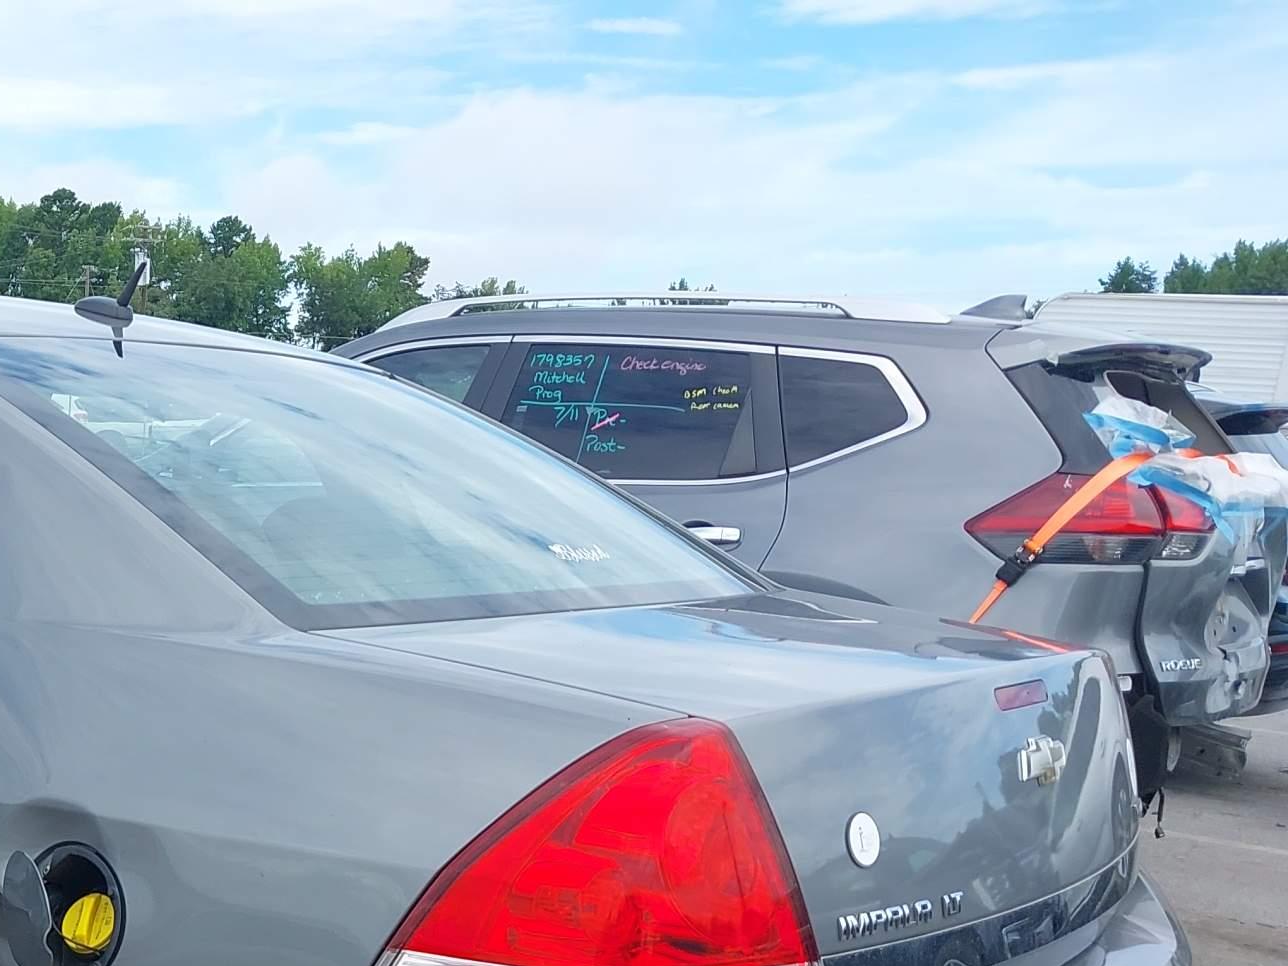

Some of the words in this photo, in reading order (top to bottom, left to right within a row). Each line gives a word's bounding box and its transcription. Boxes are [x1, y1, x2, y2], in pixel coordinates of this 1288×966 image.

[531, 354, 594, 368] 1798357
[620, 356, 659, 370] Check
[534, 371, 585, 384] Mitchell
[529, 385, 561, 405] Prog
[1161, 658, 1202, 673] ROGUE
[838, 899, 932, 941] IMPALA
[941, 891, 964, 919] LT
